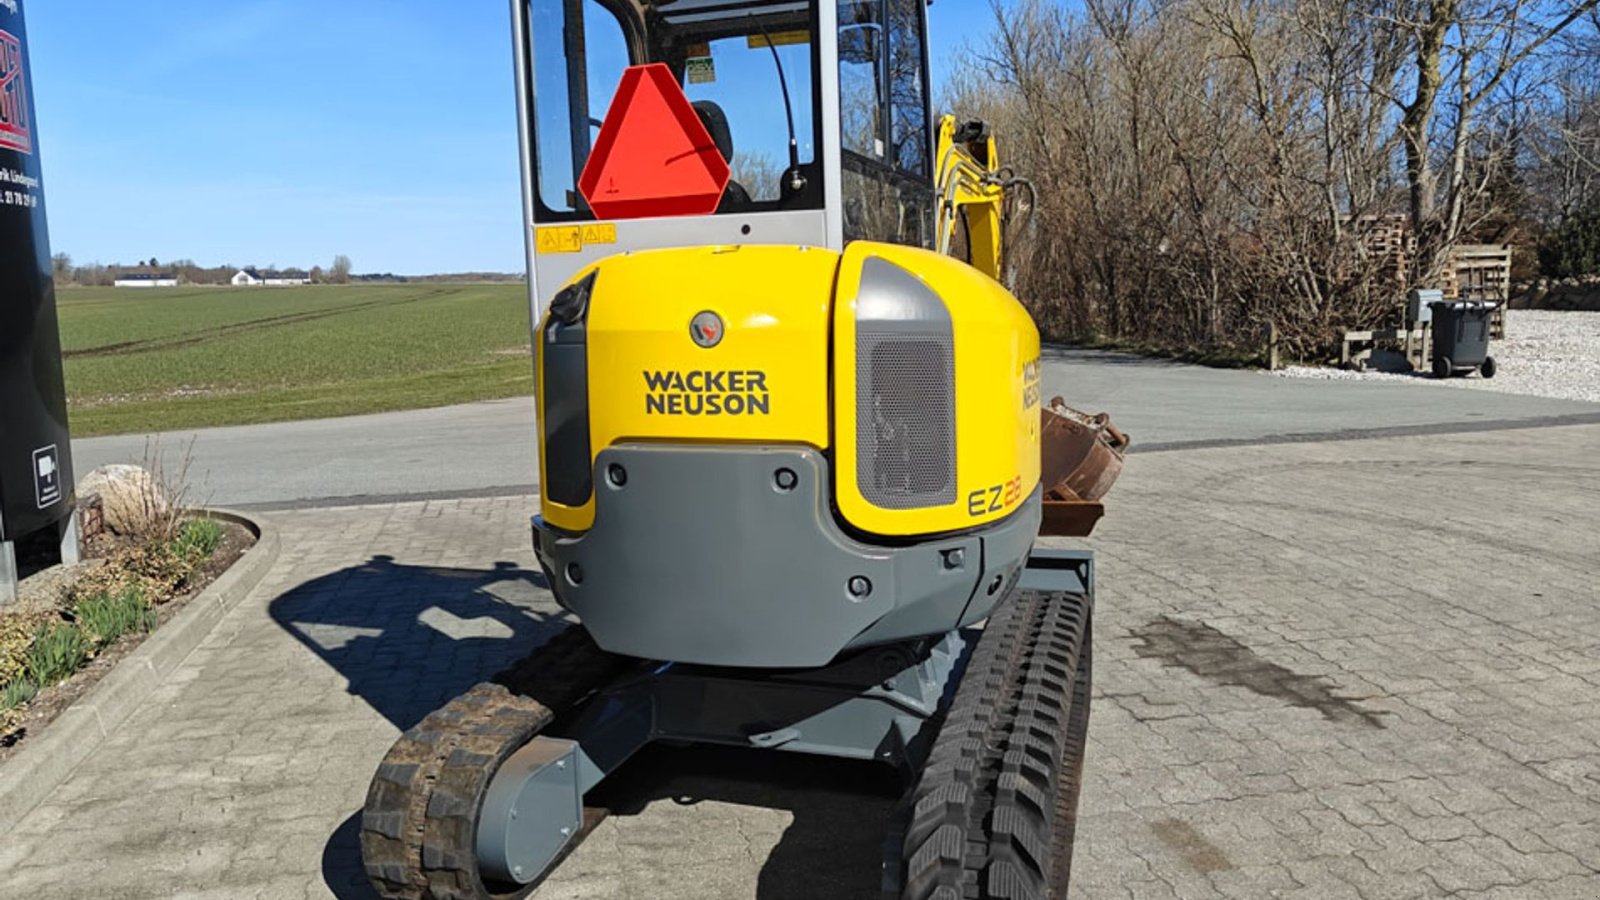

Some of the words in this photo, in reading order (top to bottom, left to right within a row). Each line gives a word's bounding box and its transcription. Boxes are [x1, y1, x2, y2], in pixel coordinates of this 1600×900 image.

[642, 370, 768, 392] WACKER
[645, 393, 770, 415] NEUSON
[968, 475, 1021, 517] EZ28
